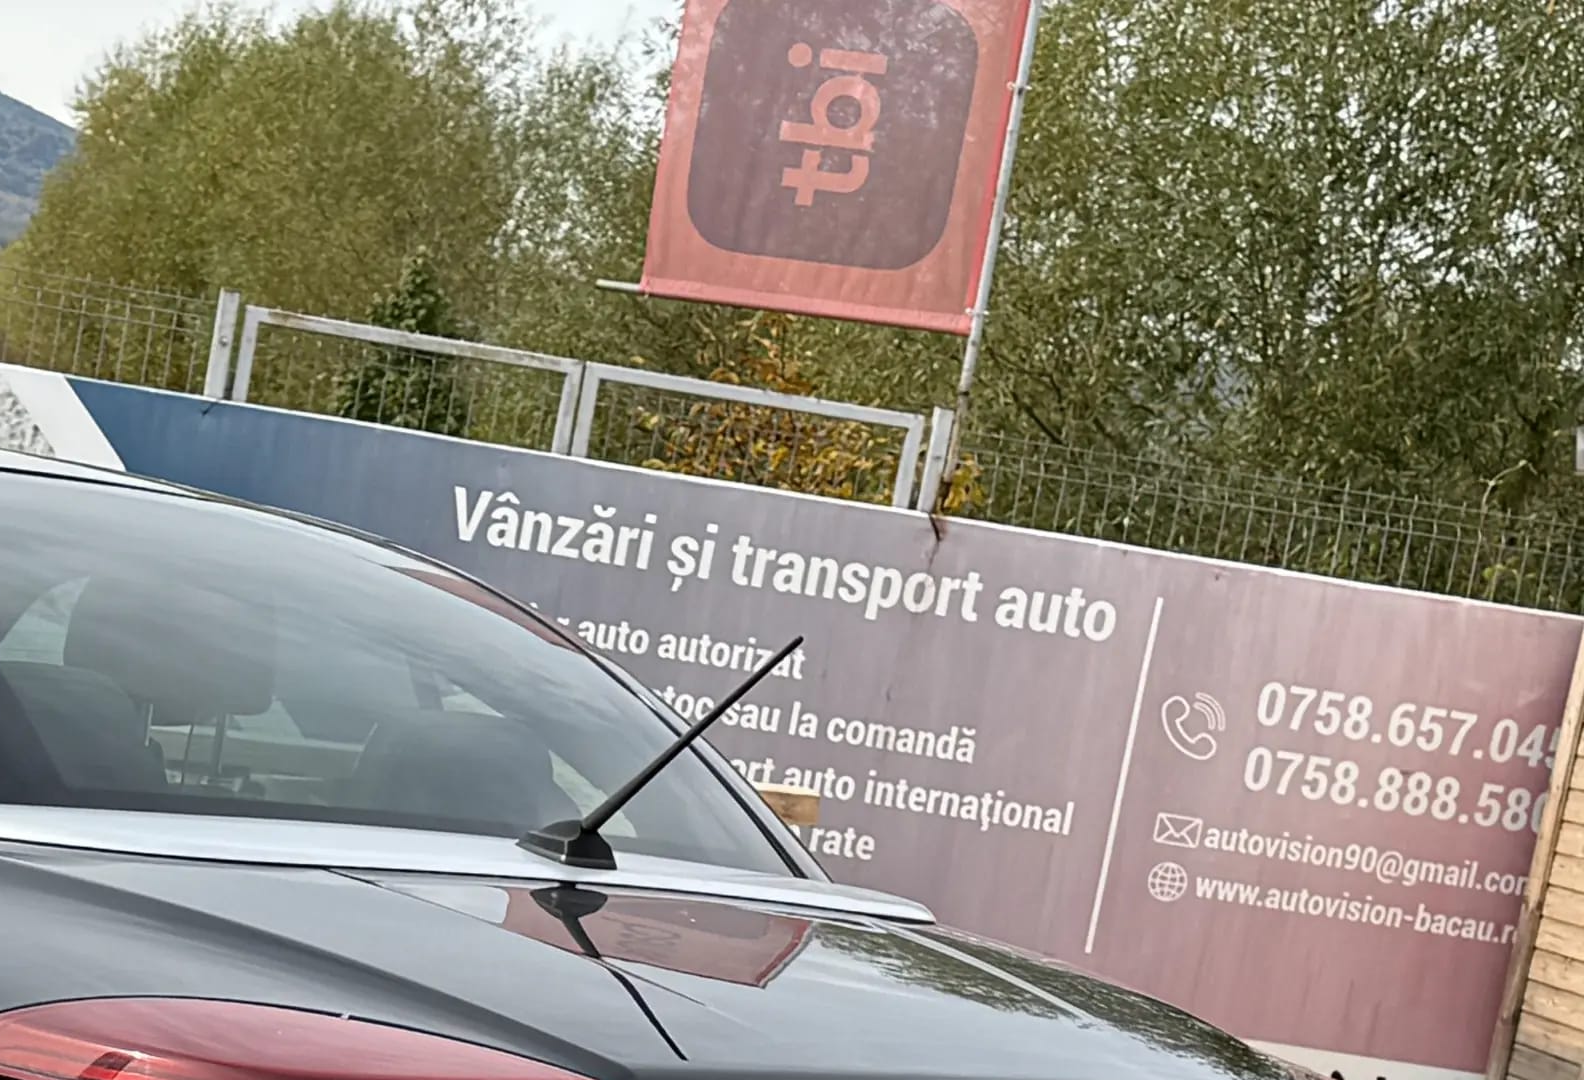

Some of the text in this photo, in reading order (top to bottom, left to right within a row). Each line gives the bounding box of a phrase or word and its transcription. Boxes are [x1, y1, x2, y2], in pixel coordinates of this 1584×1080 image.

[778, 42, 888, 207] tbi
[454, 486, 658, 570] Vânzări
[731, 535, 984, 621] transport
[994, 586, 1117, 642] auto
[577, 619, 649, 655] auto
[651, 685, 977, 763] toc sau la comandă
[809, 825, 876, 861] rate
